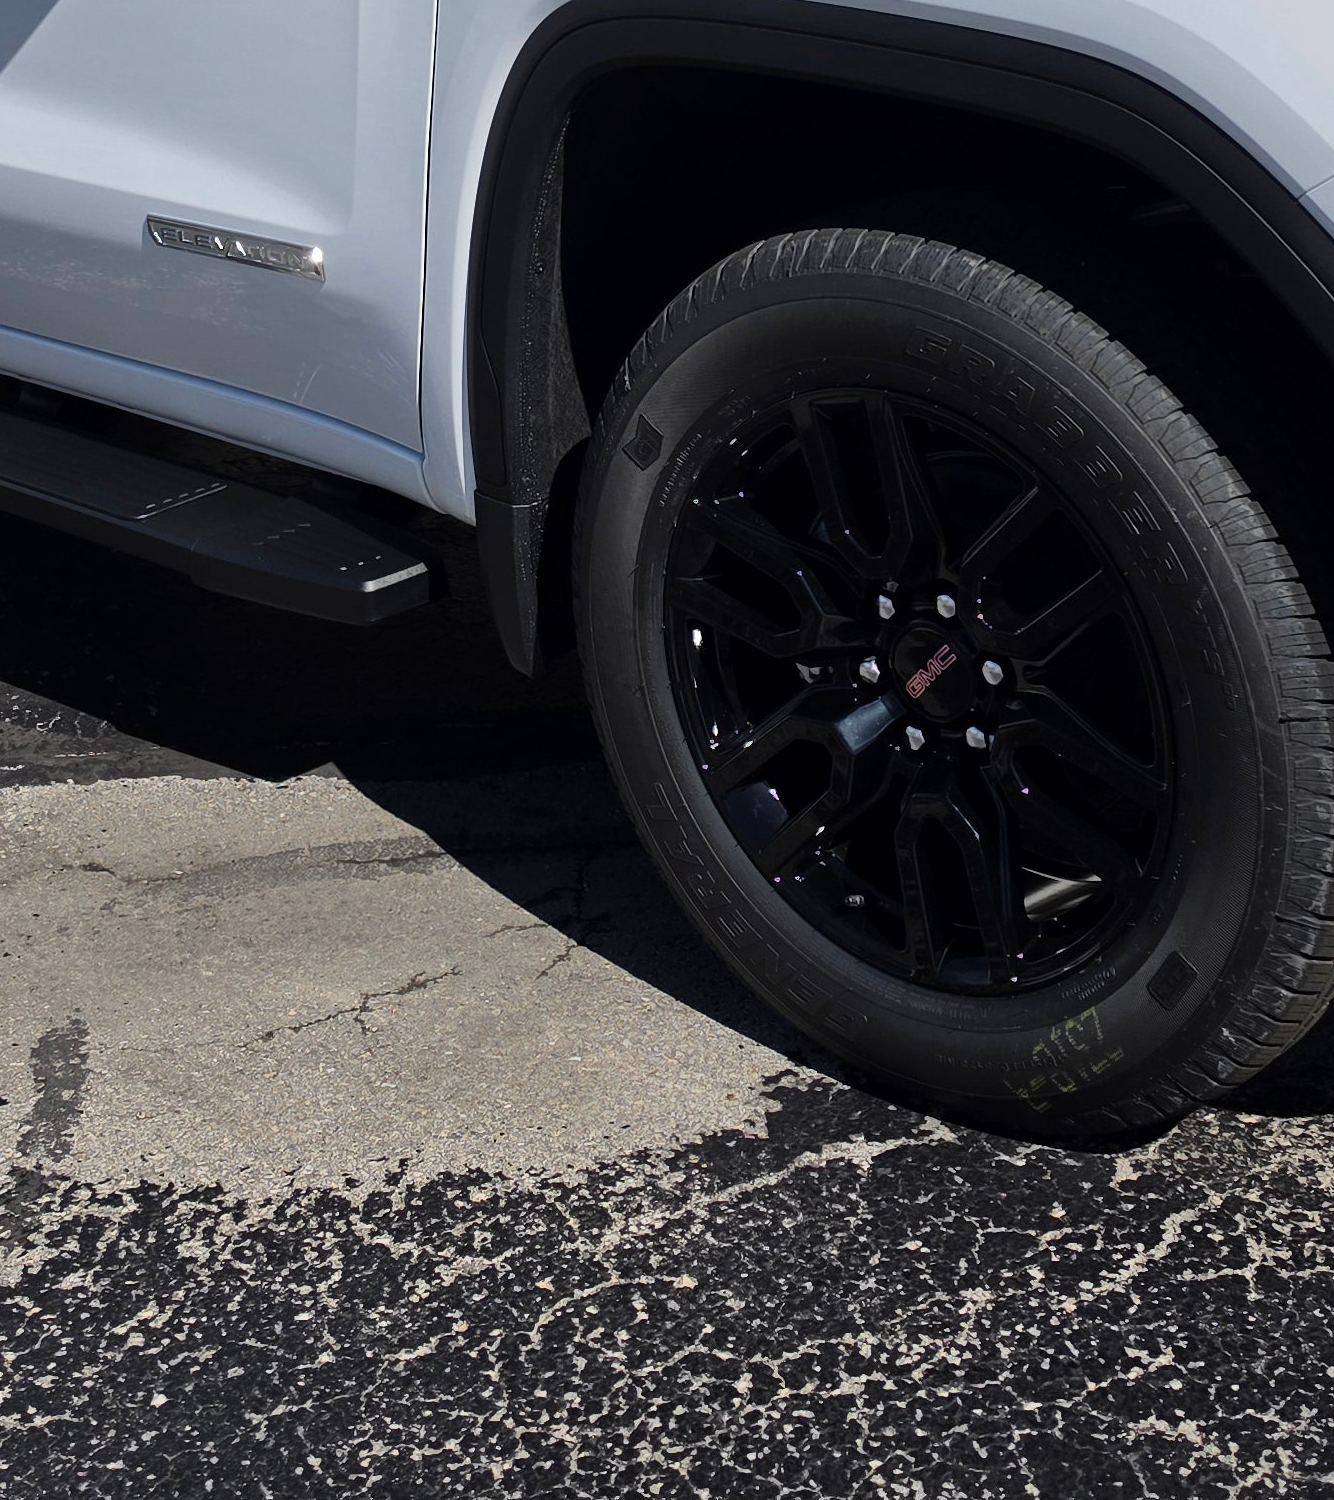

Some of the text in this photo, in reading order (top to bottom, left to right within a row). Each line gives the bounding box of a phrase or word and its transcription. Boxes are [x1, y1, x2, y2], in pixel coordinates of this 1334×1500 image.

[160, 227, 309, 273] ELEVATION
[905, 324, 1191, 587] GRABBER
[905, 644, 957, 699] GMC
[644, 781, 869, 1041] GENERAL
